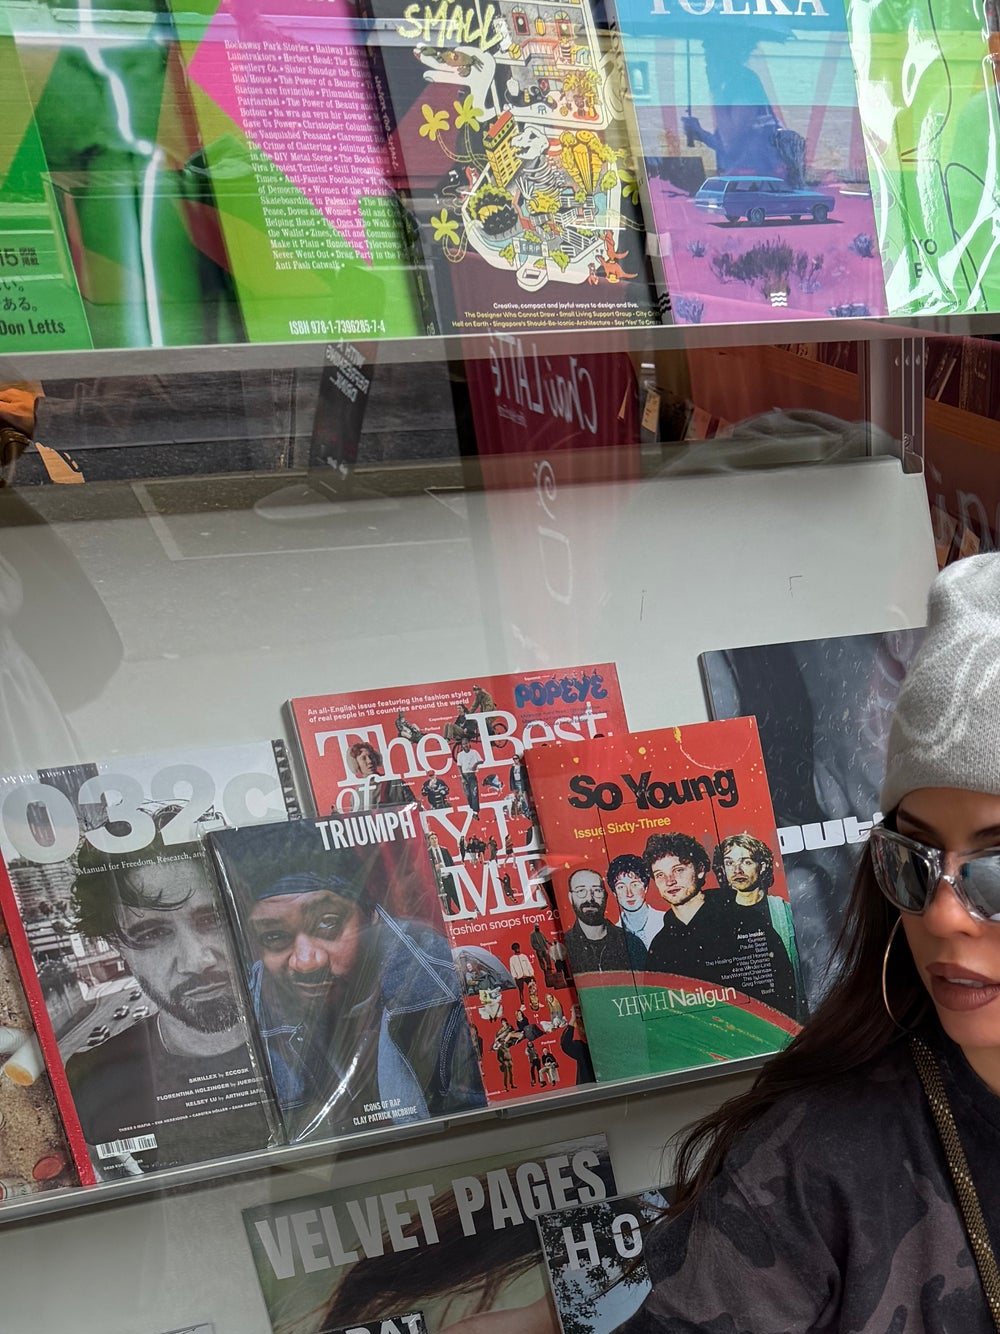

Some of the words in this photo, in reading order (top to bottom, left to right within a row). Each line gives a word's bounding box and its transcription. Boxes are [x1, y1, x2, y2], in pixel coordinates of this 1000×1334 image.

[396, 3, 501, 50] SMALL
[263, 41, 281, 51] Park
[283, 42, 309, 52] Stories
[249, 74, 272, 84] House
[278, 75, 293, 84] The
[294, 76, 317, 86] Power
[318, 77, 326, 86] of
[333, 78, 359, 88] Banner
[302, 131, 331, 141] Peasant
[337, 132, 373, 143] Claremont
[325, 207, 351, 217] Women
[373, 208, 387, 217] and
[311, 260, 340, 271] Catwalk
[493, 302, 520, 310] Creative,
[520, 302, 547, 311] compact
[547, 301, 558, 309] and
[597, 301, 616, 311] design
[616, 301, 627, 309] and
[517, 311, 539, 319] Cannot
[592, 310, 615, 319] Support
[28, 318, 66, 334] Letts
[288, 320, 310, 335] ISBN
[513, 674, 609, 709] POPEYE
[318, 703, 357, 715] all-English
[357, 701, 376, 710] issue
[377, 697, 411, 708] featuring
[411, 696, 424, 704] the
[424, 693, 450, 703] fashion
[450, 690, 472, 700] styles
[333, 711, 357, 721] people
[375, 705, 410, 715] countries
[410, 703, 436, 712] around
[449, 698, 470, 708] world
[313, 723, 453, 788] The
[335, 776, 379, 815] of
[567, 773, 623, 812] So
[620, 768, 740, 810] Young
[2, 763, 286, 865] 032c
[314, 808, 417, 851] TRIUMPH
[573, 826, 607, 839] Issue
[607, 815, 671, 834] Sixty-Three
[77, 863, 108, 876] Manual
[108, 862, 121, 871] for
[120, 857, 156, 870] Freedom,
[157, 852, 192, 865] Research,
[449, 921, 488, 937] fashion
[489, 917, 521, 931] snaps
[521, 912, 547, 925] from
[611, 990, 670, 1018] YHWH
[667, 986, 737, 1008] Nailgun
[188, 1074, 218, 1084] SKRILLEX
[156, 1089, 194, 1102] FLORENTINA
[194, 1082, 230, 1094] HOLZINGER
[185, 1099, 209, 1108] KELSEY
[225, 1090, 250, 1101] ARTHUR
[363, 1101, 381, 1113] ICONS
[381, 1100, 389, 1109] OF
[389, 1098, 401, 1108] RAP
[352, 1115, 368, 1126] CLAY
[368, 1110, 392, 1123] PATRICK
[254, 1182, 440, 1282] VELVET
[451, 1149, 608, 1239] PAGES
